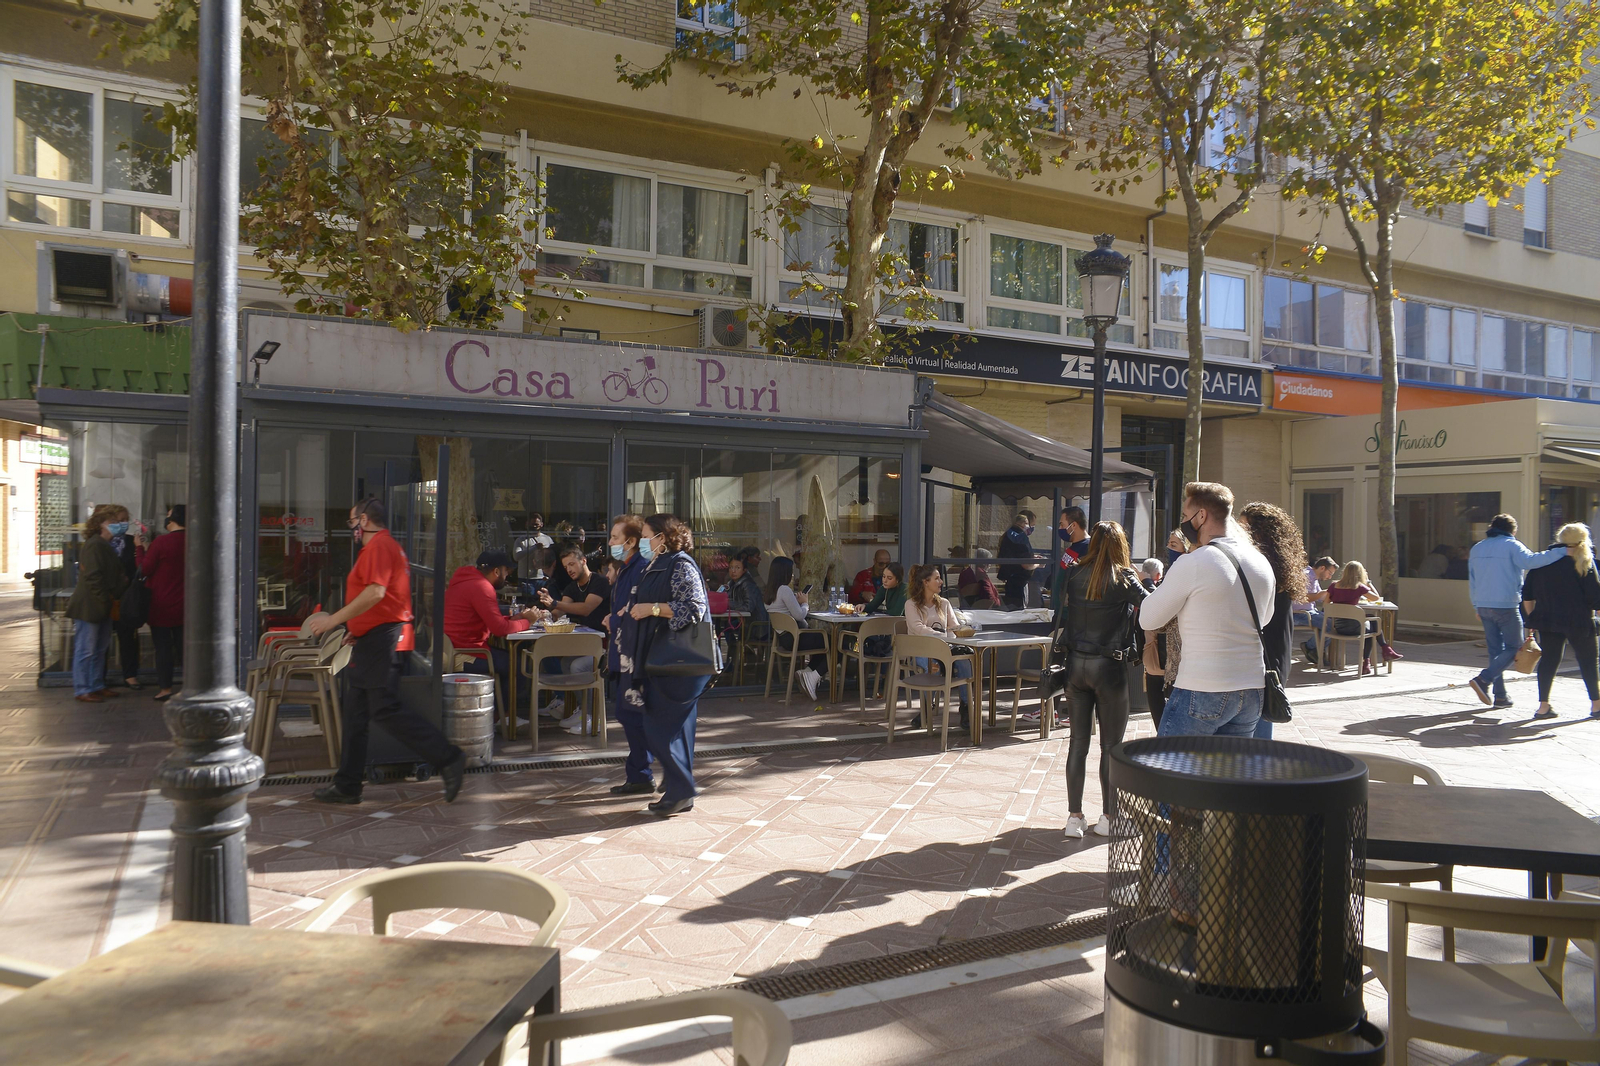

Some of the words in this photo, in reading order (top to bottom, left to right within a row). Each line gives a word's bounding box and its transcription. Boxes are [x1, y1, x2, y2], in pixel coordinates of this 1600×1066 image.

[882, 354, 913, 365] ealidad
[914, 356, 939, 368] Virtual
[944, 359, 976, 371] Realidad
[977, 362, 1019, 376] Aumentada
[1060, 353, 1259, 398] ZEAINFORAFIA
[445, 340, 575, 399] Casa
[696, 359, 780, 414] Puri
[1280, 381, 1333, 399] Ciudadanos
[301, 540, 329, 554] Puri
